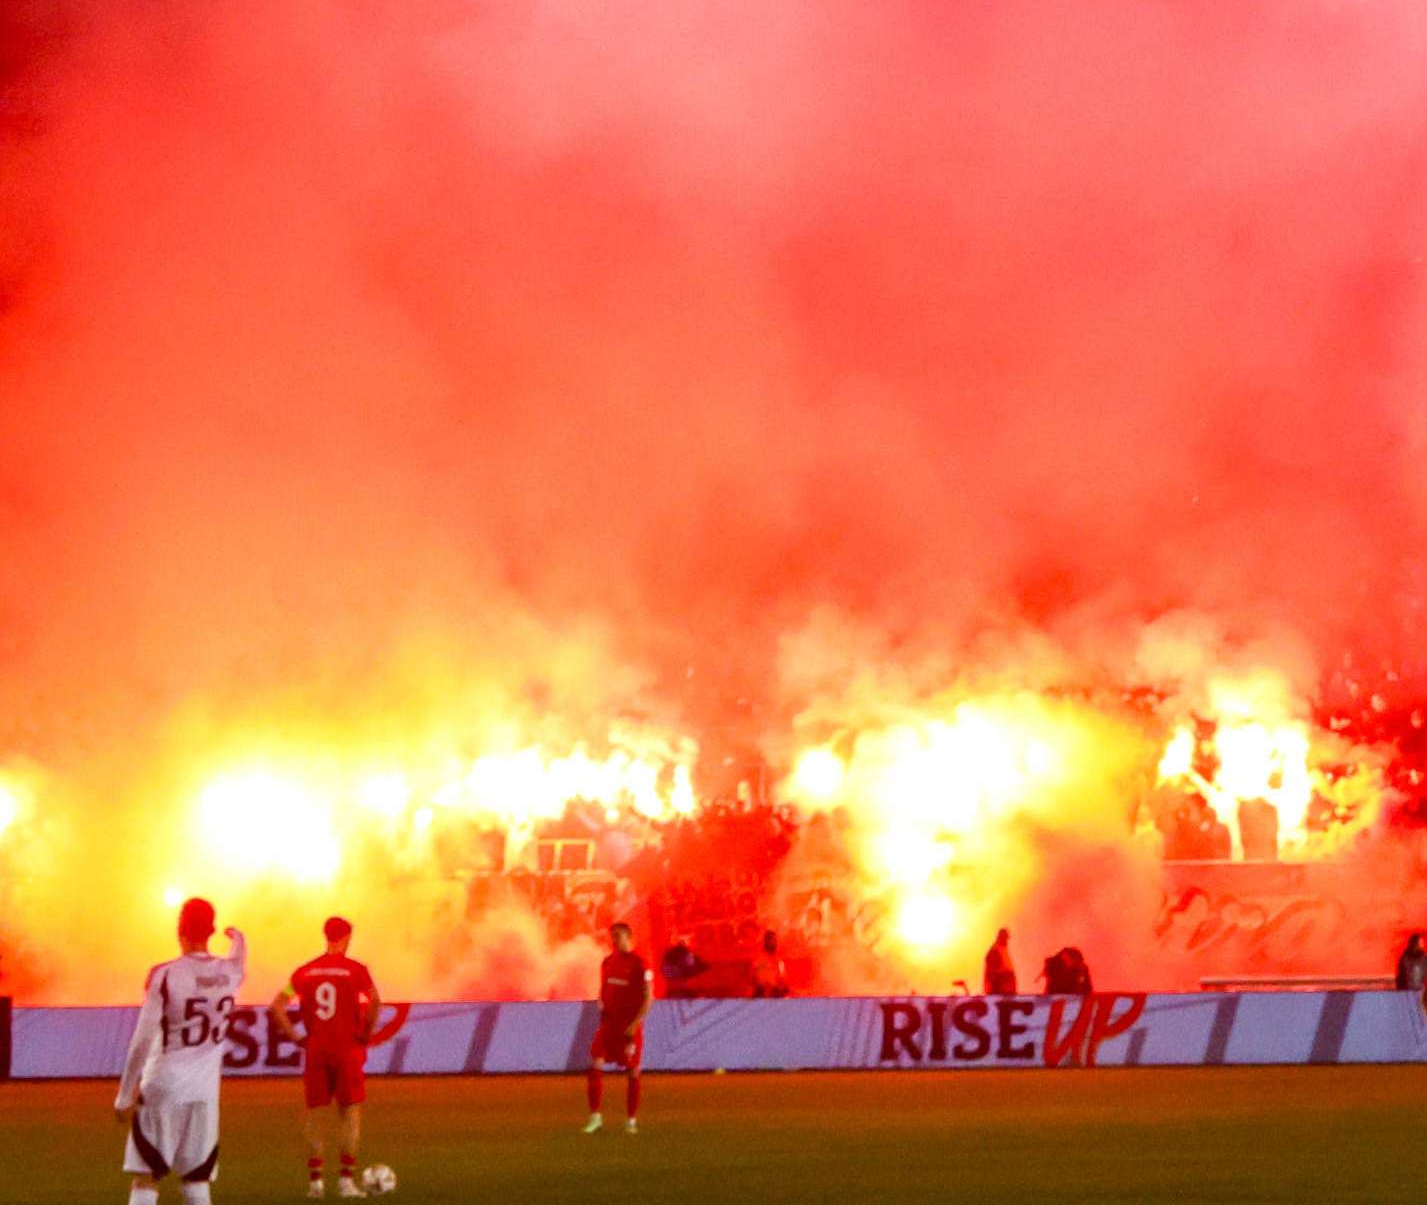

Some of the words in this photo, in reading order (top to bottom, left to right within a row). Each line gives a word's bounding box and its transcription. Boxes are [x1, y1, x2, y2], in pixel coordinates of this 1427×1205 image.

[182, 995, 236, 1048] 53
[315, 981, 337, 1021] 9
[879, 1000, 1036, 1062] RISE
[1042, 992, 1149, 1070] UP
